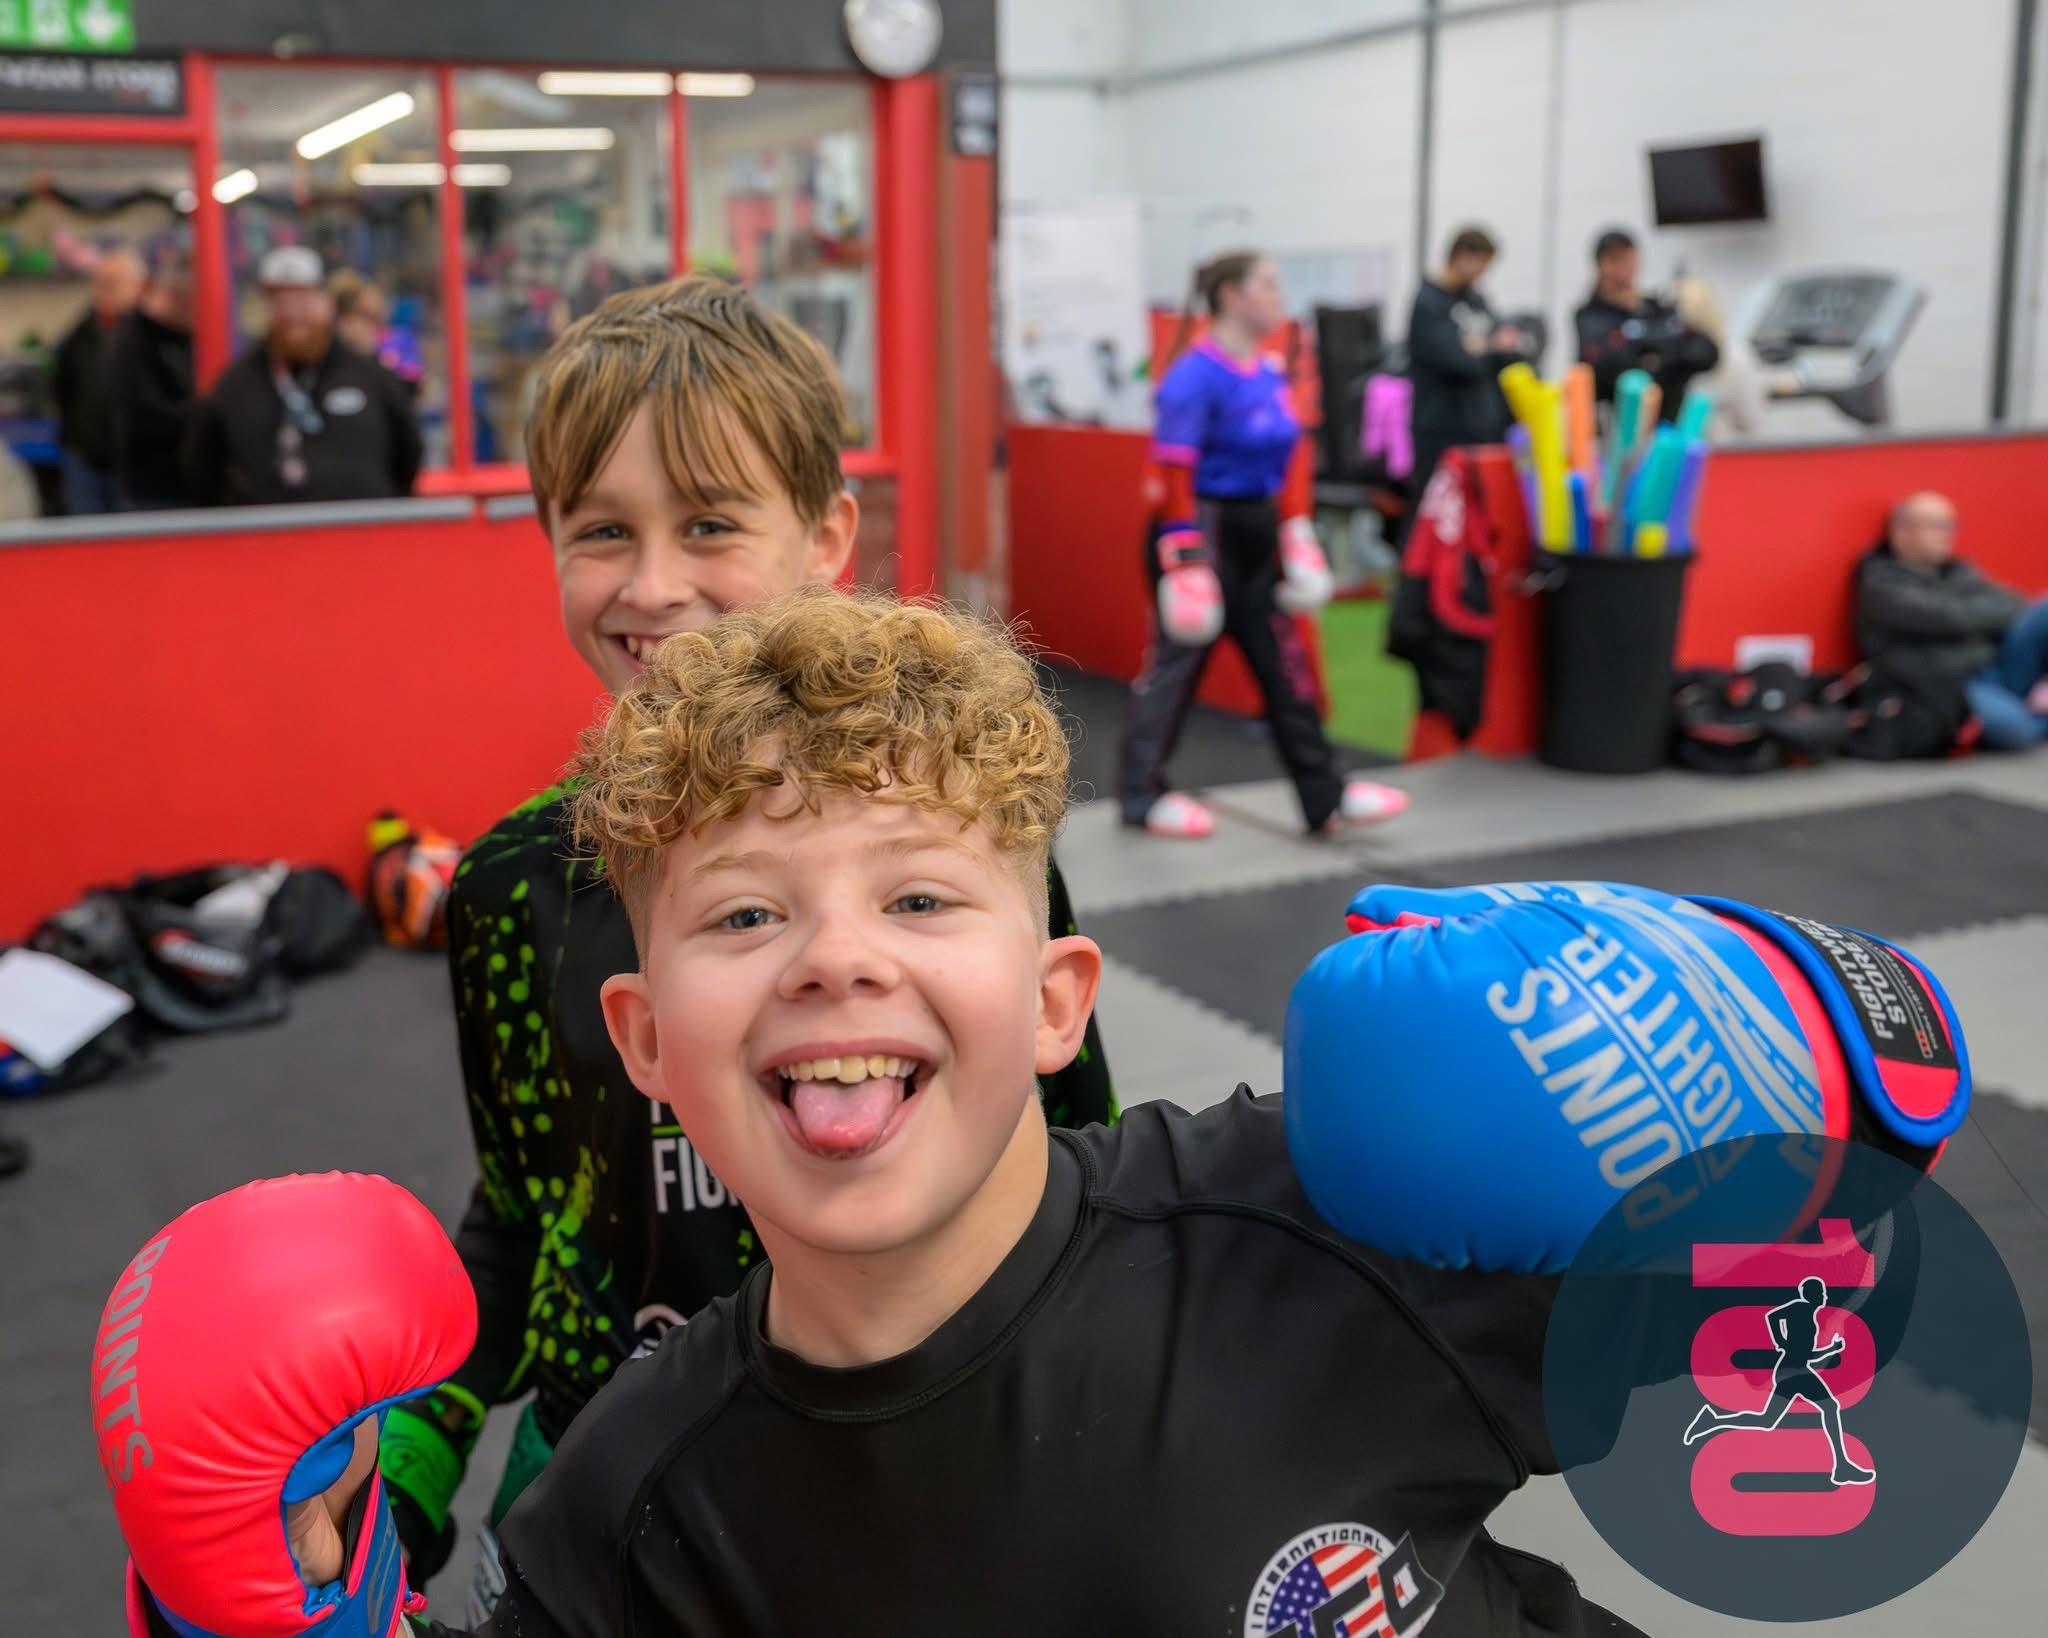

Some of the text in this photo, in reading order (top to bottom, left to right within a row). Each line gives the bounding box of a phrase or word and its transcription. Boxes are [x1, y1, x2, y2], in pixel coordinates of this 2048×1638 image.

[1486, 966, 1700, 1233] POINTS
[1838, 939, 1907, 1024] STORE
[100, 1234, 172, 1484] POINTS
